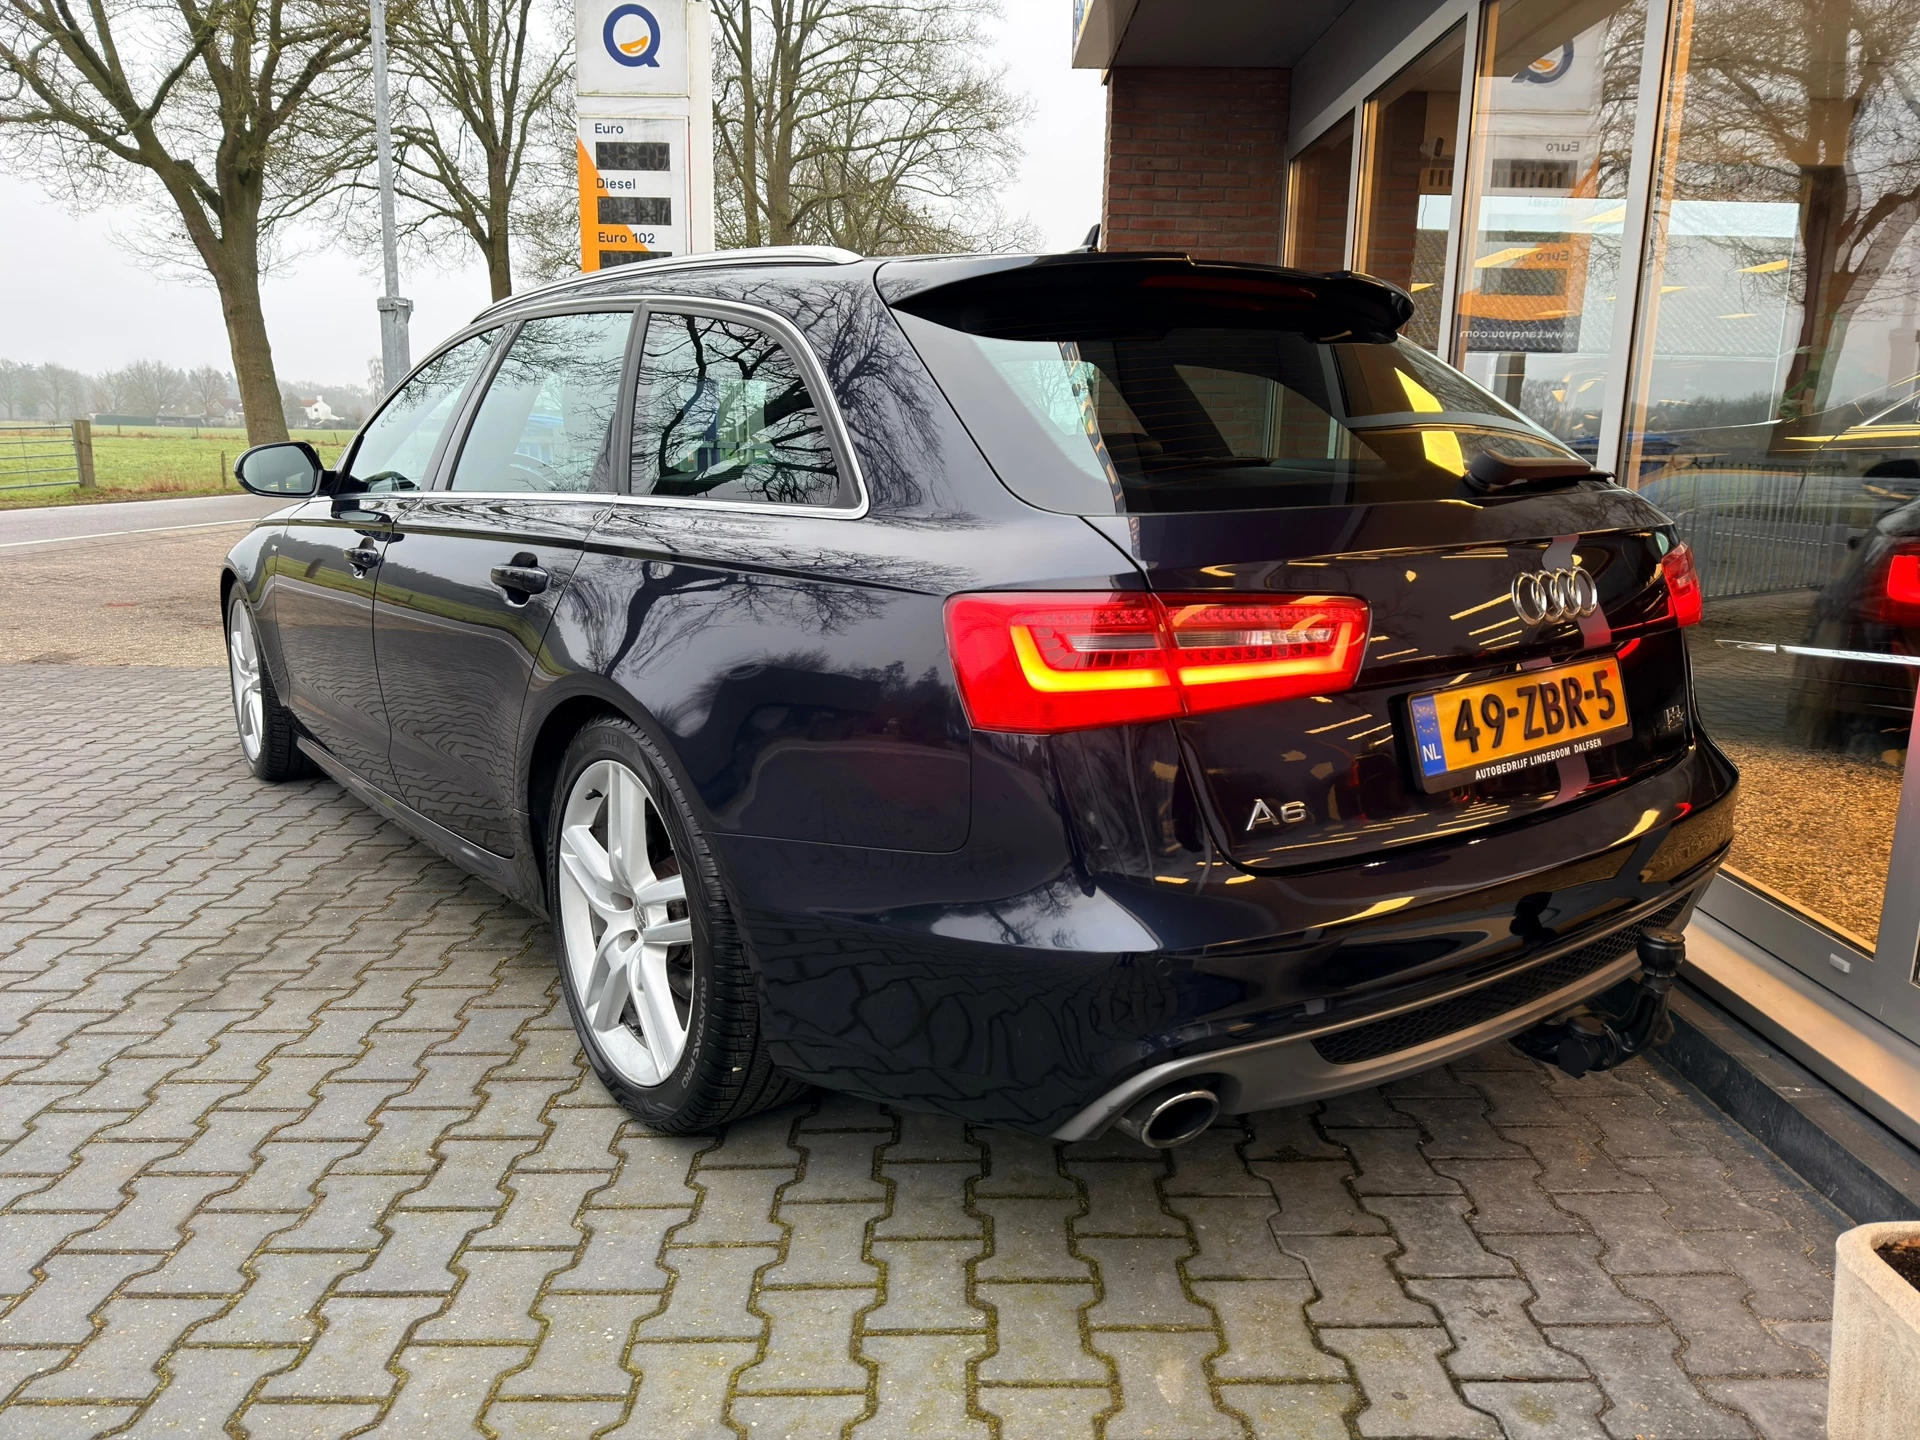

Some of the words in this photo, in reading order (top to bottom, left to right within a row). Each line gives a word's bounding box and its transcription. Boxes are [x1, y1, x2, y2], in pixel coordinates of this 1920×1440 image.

[603, 4, 661, 67] Q
[594, 123, 624, 135] Euro
[596, 178, 636, 190] Diesel
[598, 232, 628, 244] Euro
[632, 233, 655, 244] 102
[1454, 669, 1617, 753] 49-ZBR-5
[1422, 743, 1442, 762] NL
[1475, 757, 1529, 780] AUTOBEDRIJF
[1530, 747, 1571, 766] LINDEBOOM
[1573, 737, 1602, 754] DALFSEN
[1245, 798, 1307, 831] A6
[691, 977, 708, 1060] QUATRAC
[681, 1057, 696, 1089] PRO
